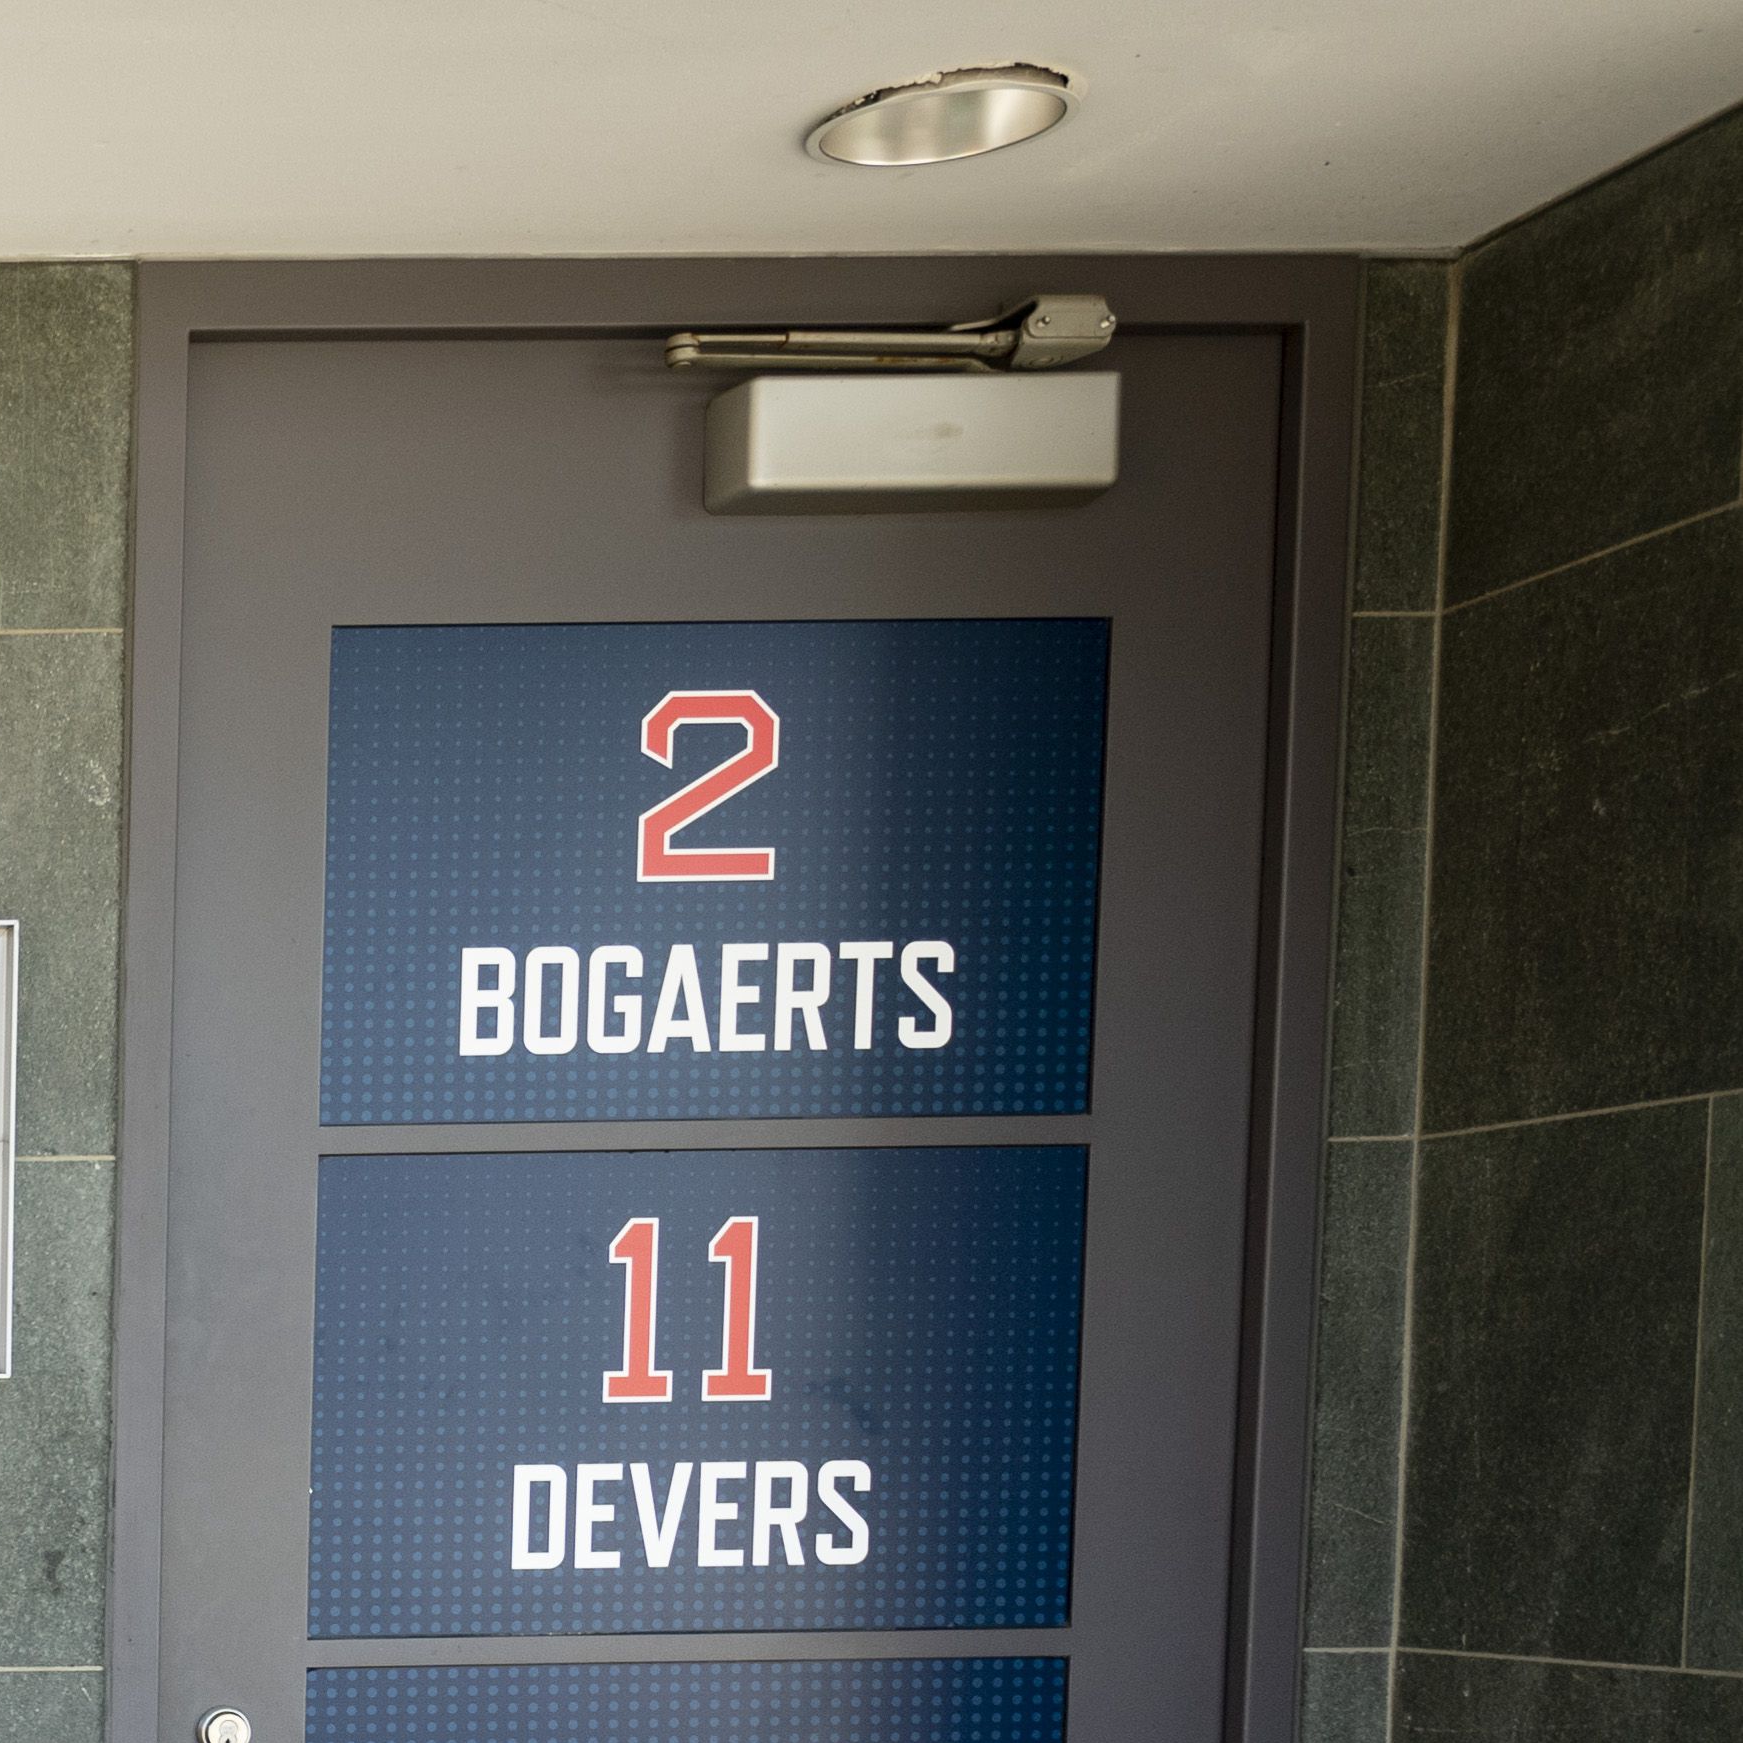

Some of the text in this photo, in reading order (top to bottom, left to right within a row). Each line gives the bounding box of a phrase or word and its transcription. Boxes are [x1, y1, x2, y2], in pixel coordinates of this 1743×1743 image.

[637, 690, 780, 882] 2
[459, 941, 954, 1056] BOGAERTS
[602, 1216, 772, 1403] 11
[511, 1460, 871, 1570] DEVERS
